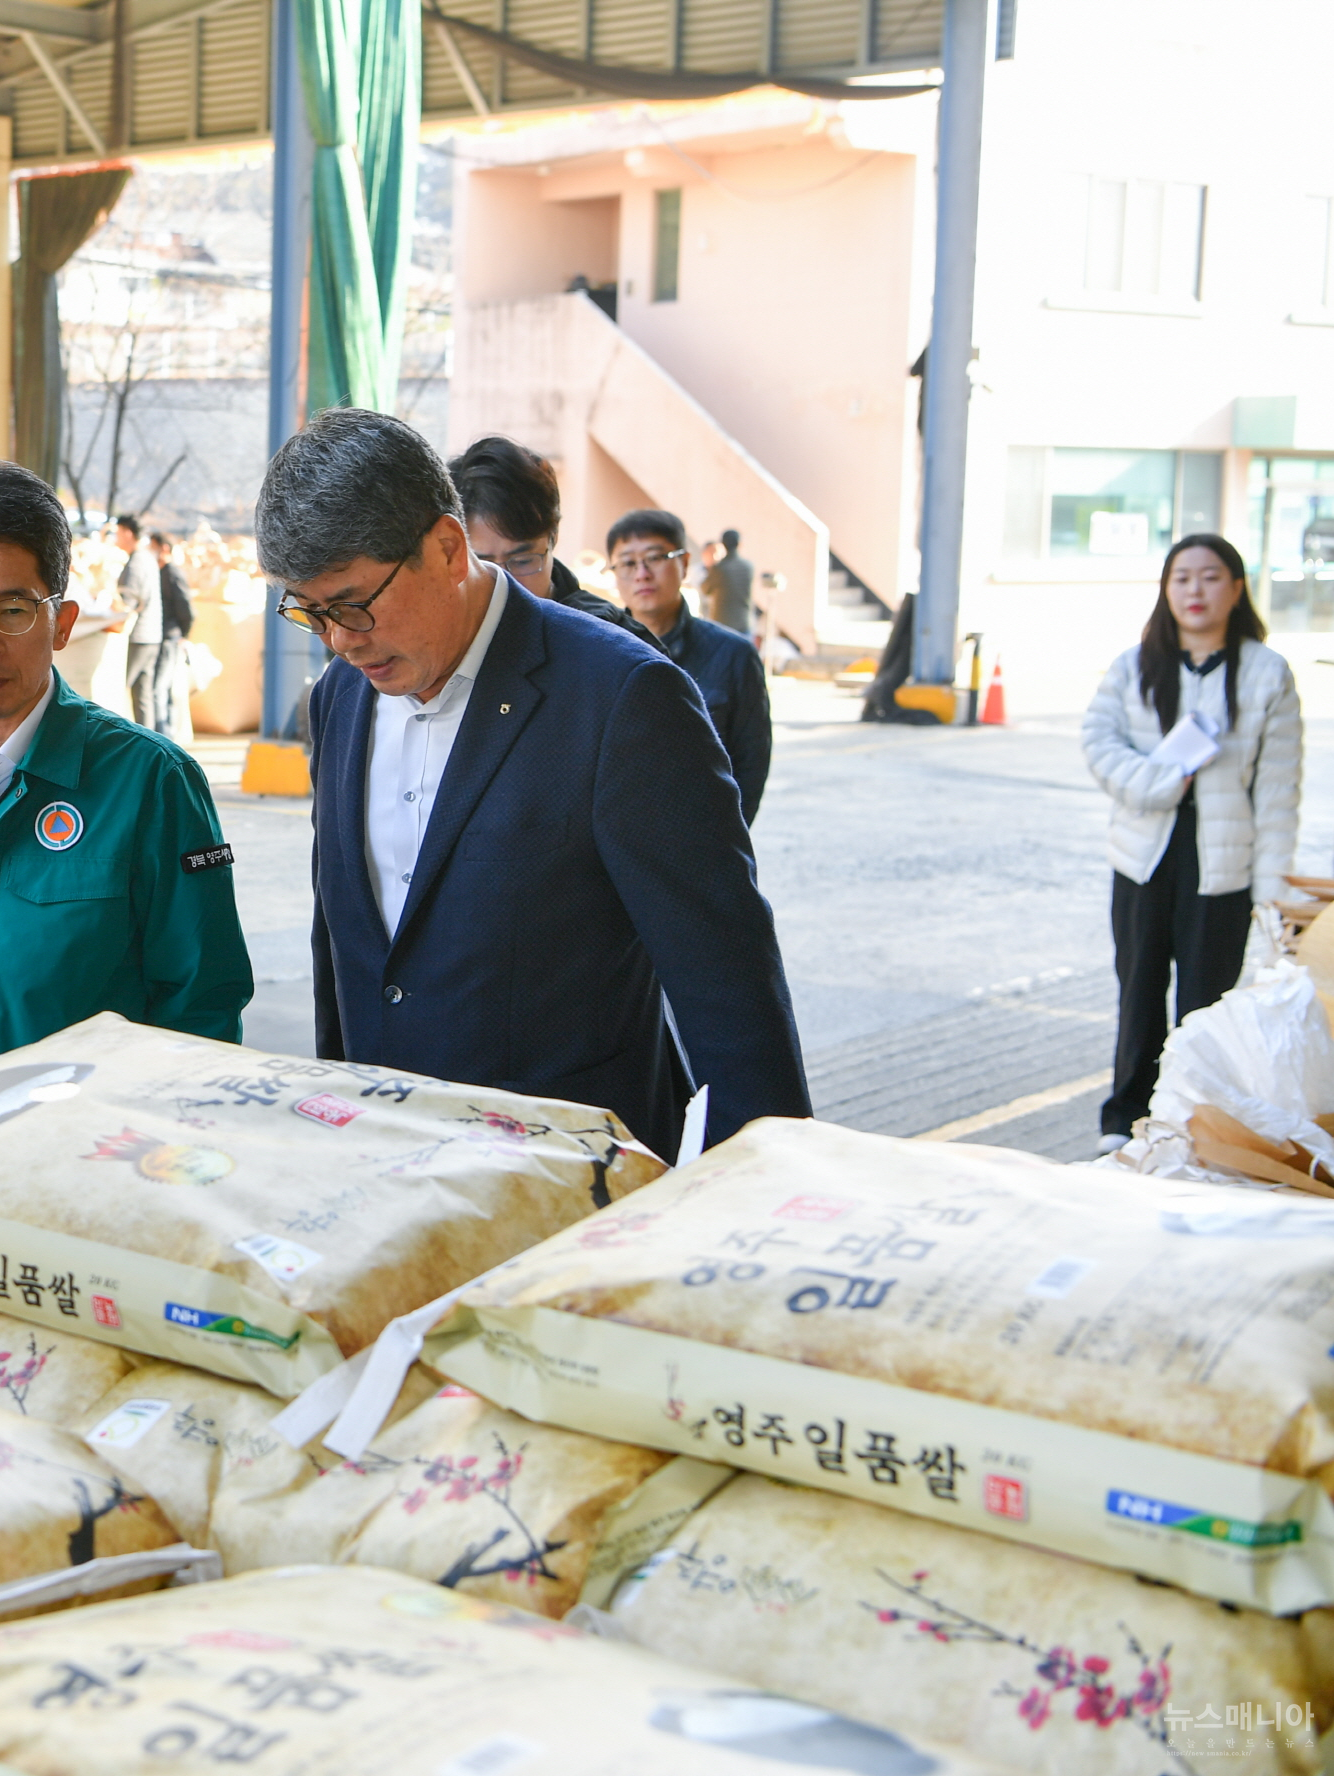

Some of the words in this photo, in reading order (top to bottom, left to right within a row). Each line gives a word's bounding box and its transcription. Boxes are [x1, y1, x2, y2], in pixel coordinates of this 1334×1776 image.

[187, 854, 206, 868] 경북
[171, 1306, 200, 1326] NH
[1117, 1494, 1164, 1522] NH
